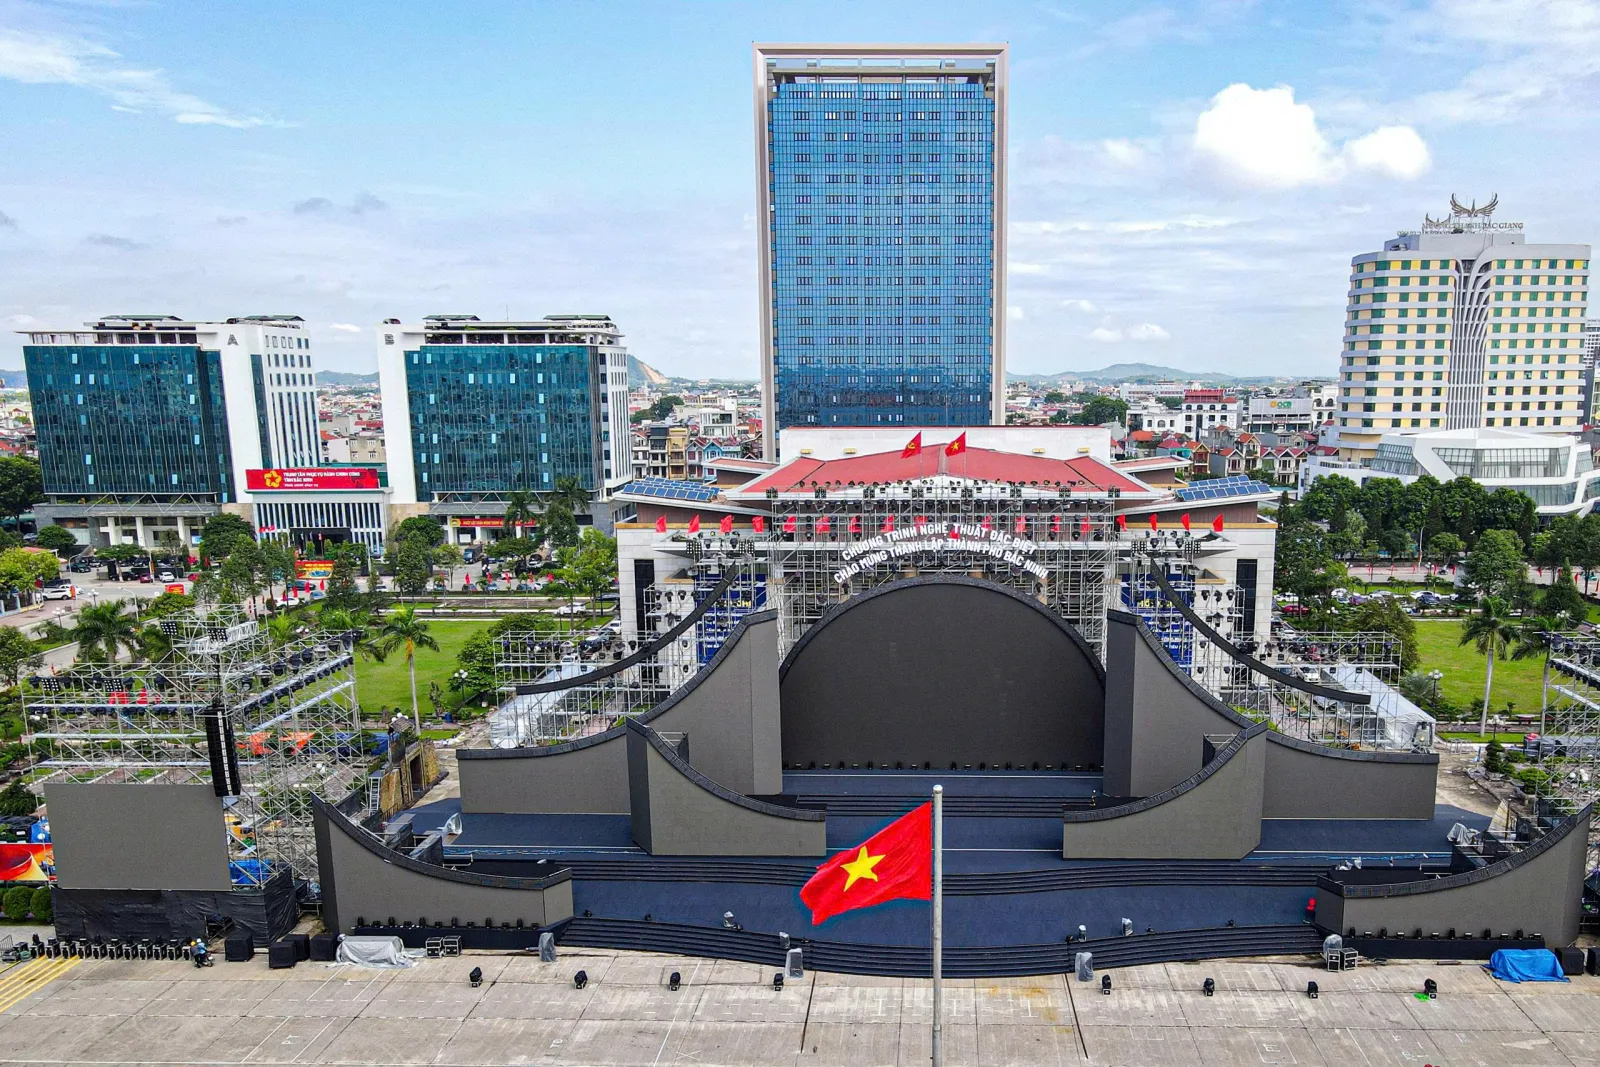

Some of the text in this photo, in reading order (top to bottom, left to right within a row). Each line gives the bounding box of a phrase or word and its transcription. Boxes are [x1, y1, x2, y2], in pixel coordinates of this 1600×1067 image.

[227, 334, 238, 345] A
[384, 334, 394, 345] B
[884, 526, 917, 541] TRÌNH
[920, 521, 948, 536] NGHỆ
[952, 523, 989, 539] THUẬT
[1012, 537, 1038, 554] BIỆT
[834, 563, 860, 583] CHÀO
[925, 536, 944, 552] LẬP
[947, 537, 981, 552] THÀNH
[1024, 559, 1049, 579] NINH
